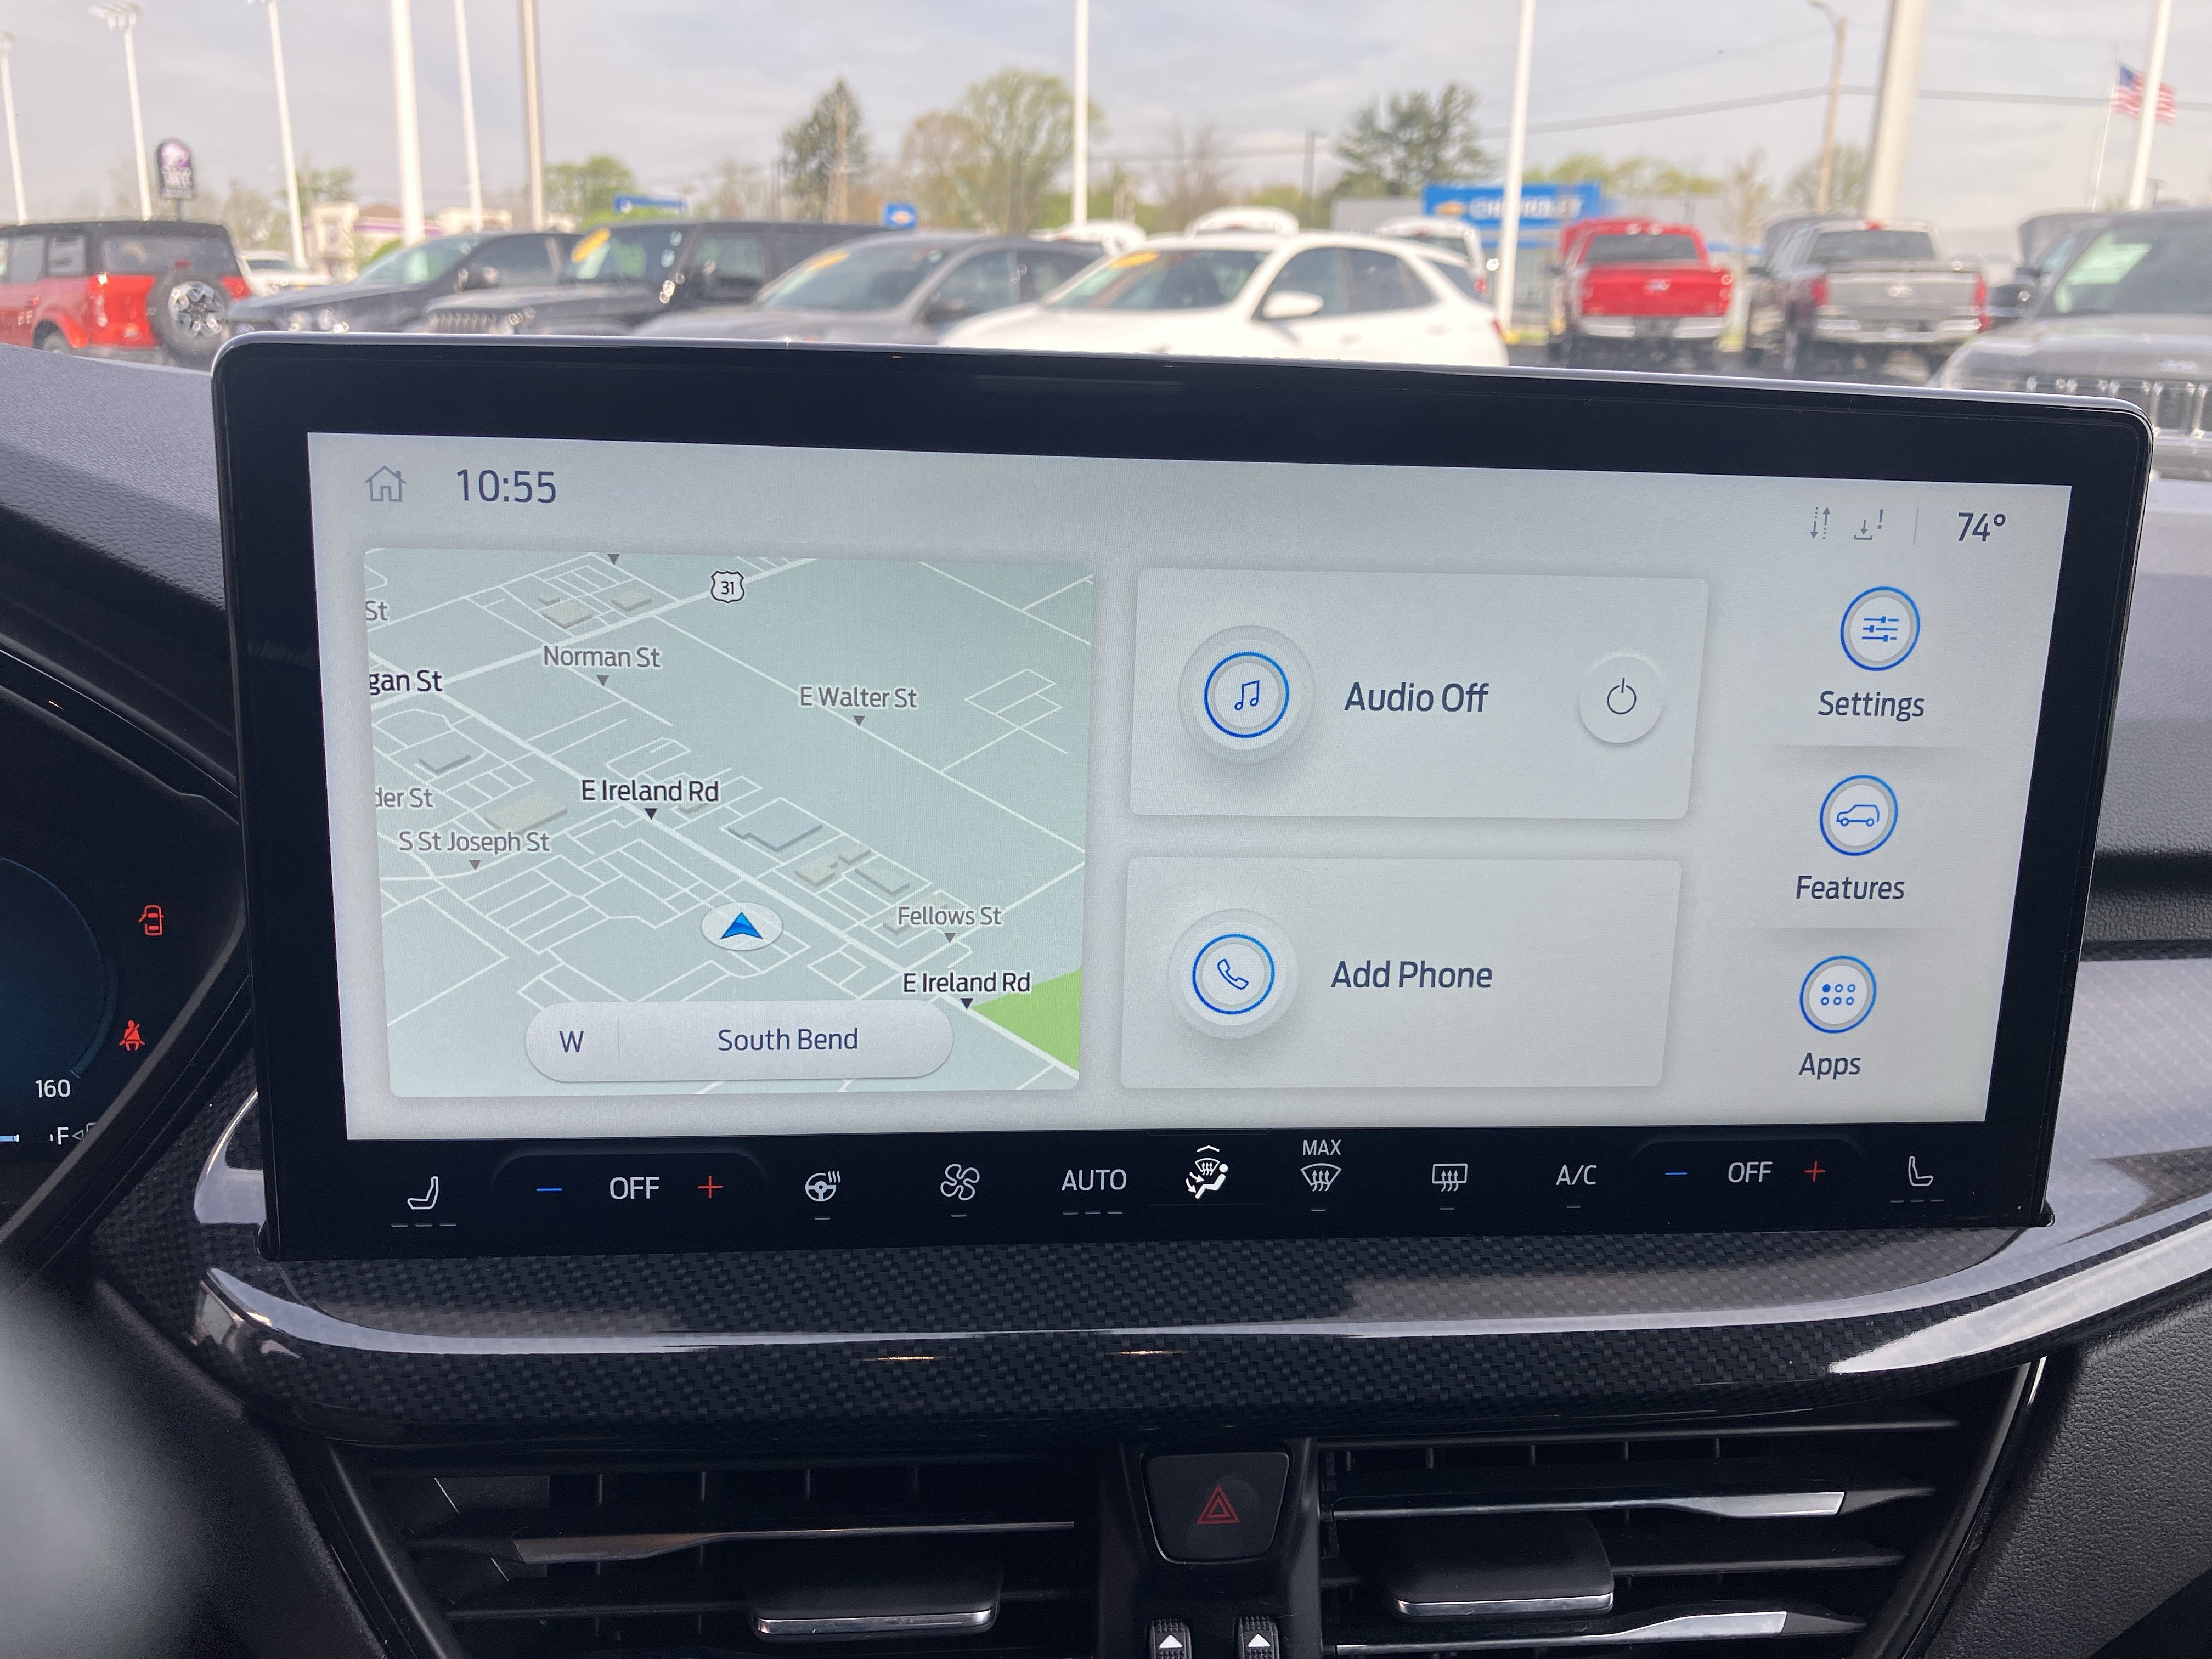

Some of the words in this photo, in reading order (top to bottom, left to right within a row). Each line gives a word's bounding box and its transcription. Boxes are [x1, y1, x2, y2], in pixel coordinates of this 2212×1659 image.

[456, 469, 557, 504] 10:55
[1957, 512, 2007, 543] 74°
[720, 580, 735, 595] 31
[365, 600, 388, 622] St
[543, 645, 631, 668] Norman
[636, 646, 661, 668] St
[416, 669, 443, 692] St
[800, 686, 813, 707] E
[817, 686, 890, 708] Walter
[894, 687, 917, 708] St
[1343, 681, 1435, 712] Audio
[1441, 682, 1490, 713] Off
[1817, 690, 1925, 723] Settings
[409, 787, 434, 809] St
[582, 779, 596, 801] E
[602, 778, 682, 802] Ireland
[689, 780, 719, 803] Rd
[398, 830, 414, 851] S
[417, 831, 442, 851] St
[447, 831, 521, 855] Joseph
[526, 831, 550, 853] St
[1795, 874, 1905, 900] Features
[898, 905, 975, 926] Fellows
[979, 906, 1002, 926] St
[903, 972, 917, 993] E
[922, 971, 997, 993] Ireland
[1002, 971, 1031, 992] Rd
[1330, 959, 1391, 989] Add
[1398, 960, 1493, 989] Phone
[558, 1030, 585, 1053] W
[718, 1027, 791, 1052] South
[798, 1026, 858, 1051] Bend
[1798, 1052, 1861, 1081] Apps
[35, 1079, 71, 1098] 160
[57, 1126, 69, 1146] F
[1302, 1139, 1342, 1156] MAX
[1060, 1168, 1127, 1192] AUTO
[1555, 1164, 1598, 1186] A/C
[1728, 1161, 1774, 1183] OFF
[609, 1176, 661, 1200] OFF
